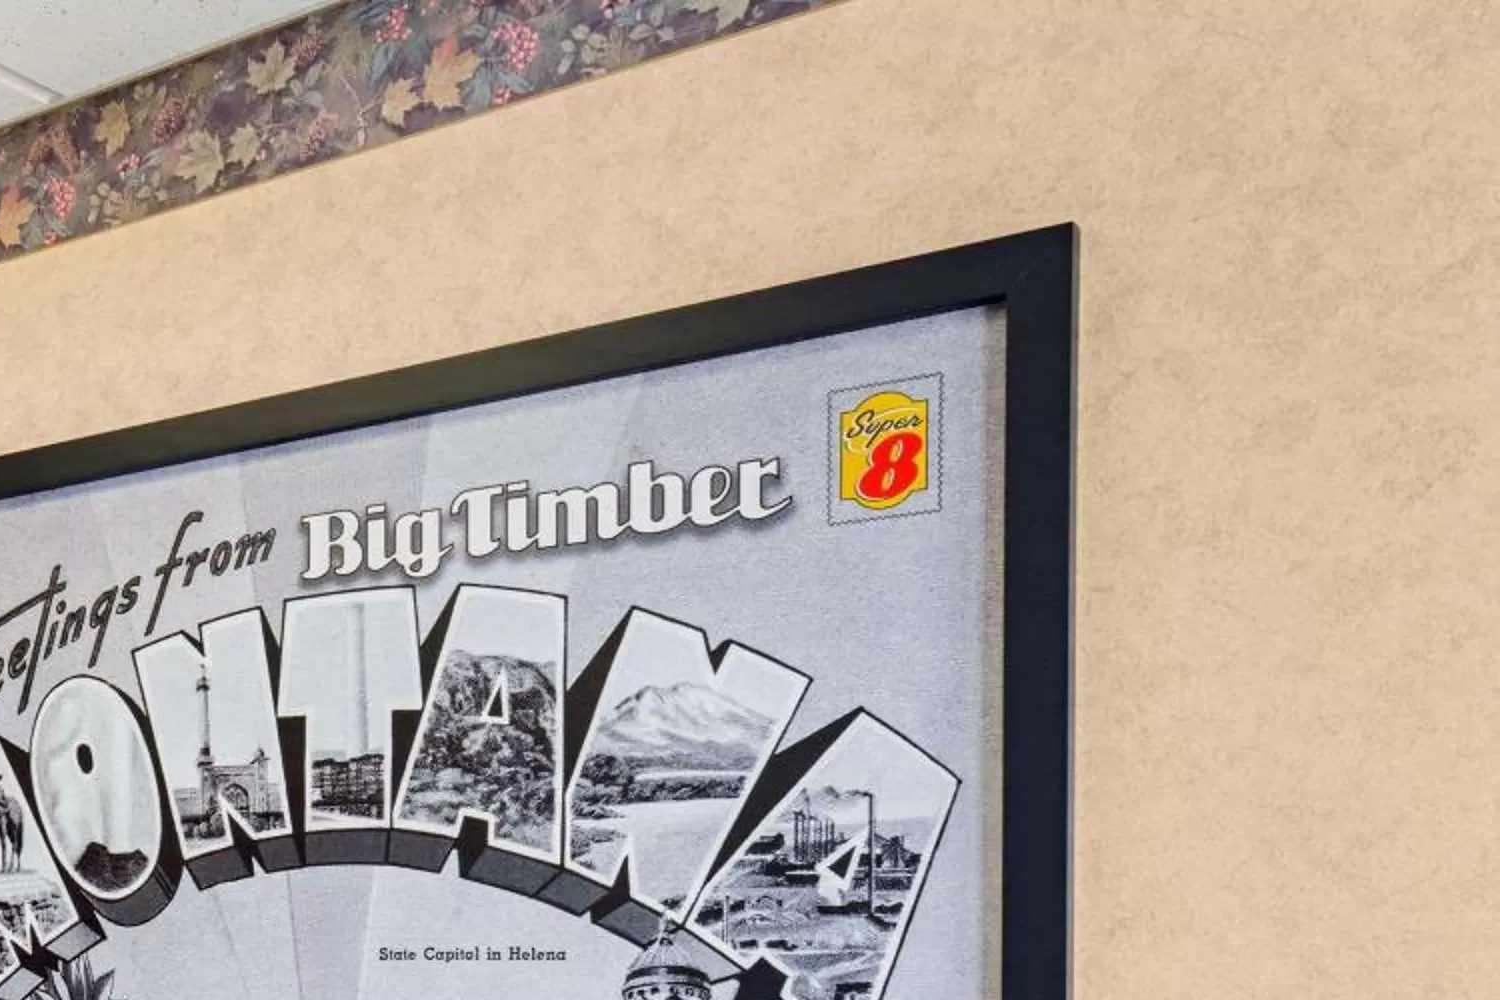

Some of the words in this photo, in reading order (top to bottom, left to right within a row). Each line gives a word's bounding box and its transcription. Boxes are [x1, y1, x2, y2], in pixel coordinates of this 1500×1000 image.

[846, 409, 924, 449] Super
[856, 431, 924, 501] 8
[144, 511, 277, 637] from
[378, 947, 417, 962] State
[486, 946, 502, 962] in
[508, 946, 567, 962] Helena
